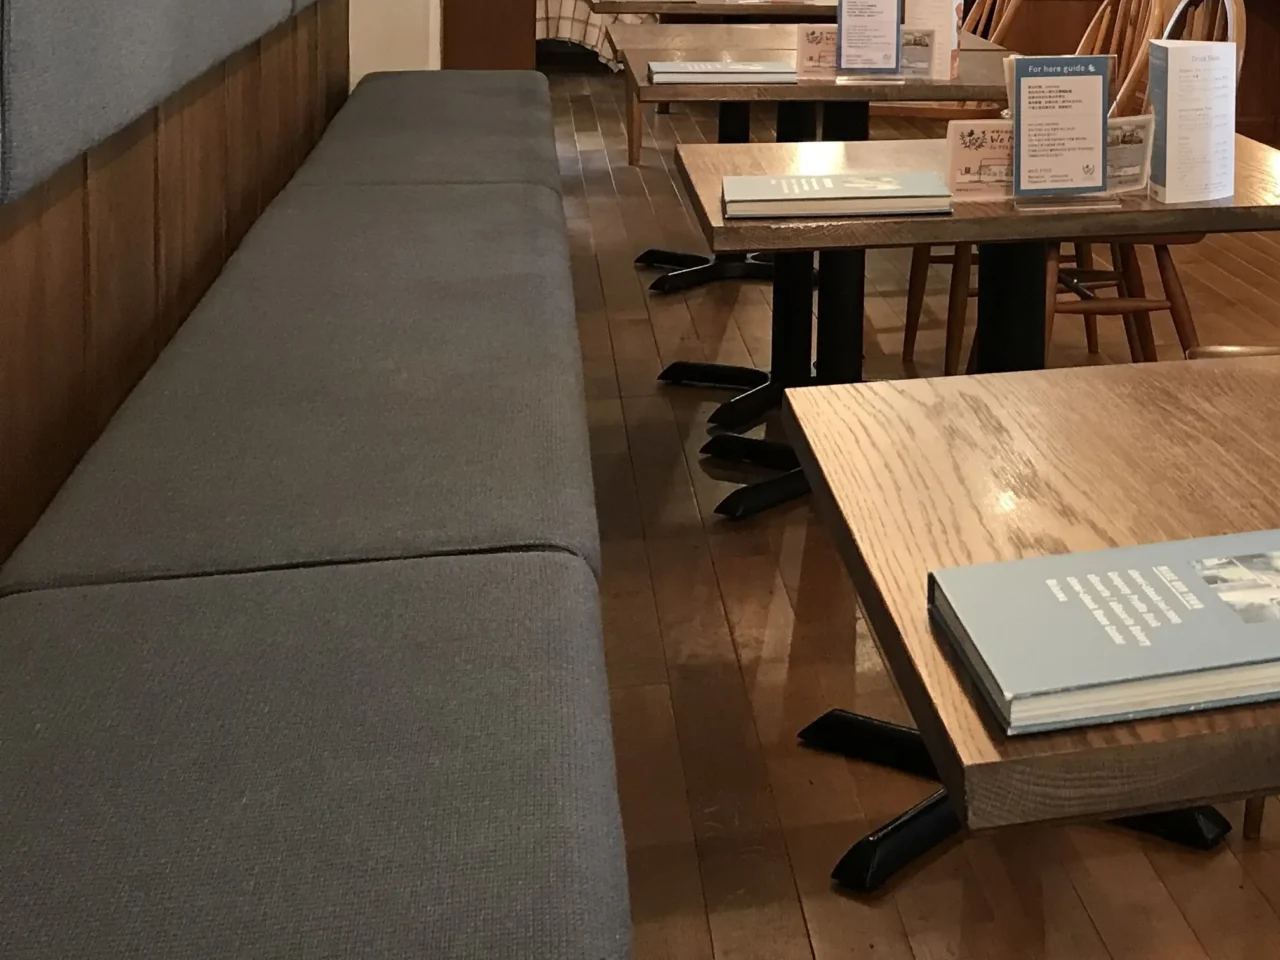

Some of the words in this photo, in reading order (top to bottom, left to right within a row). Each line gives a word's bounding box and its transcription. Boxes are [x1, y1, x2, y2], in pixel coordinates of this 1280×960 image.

[1028, 65, 1042, 73] For
[1043, 65, 1061, 73] here
[1063, 64, 1086, 74] guide
